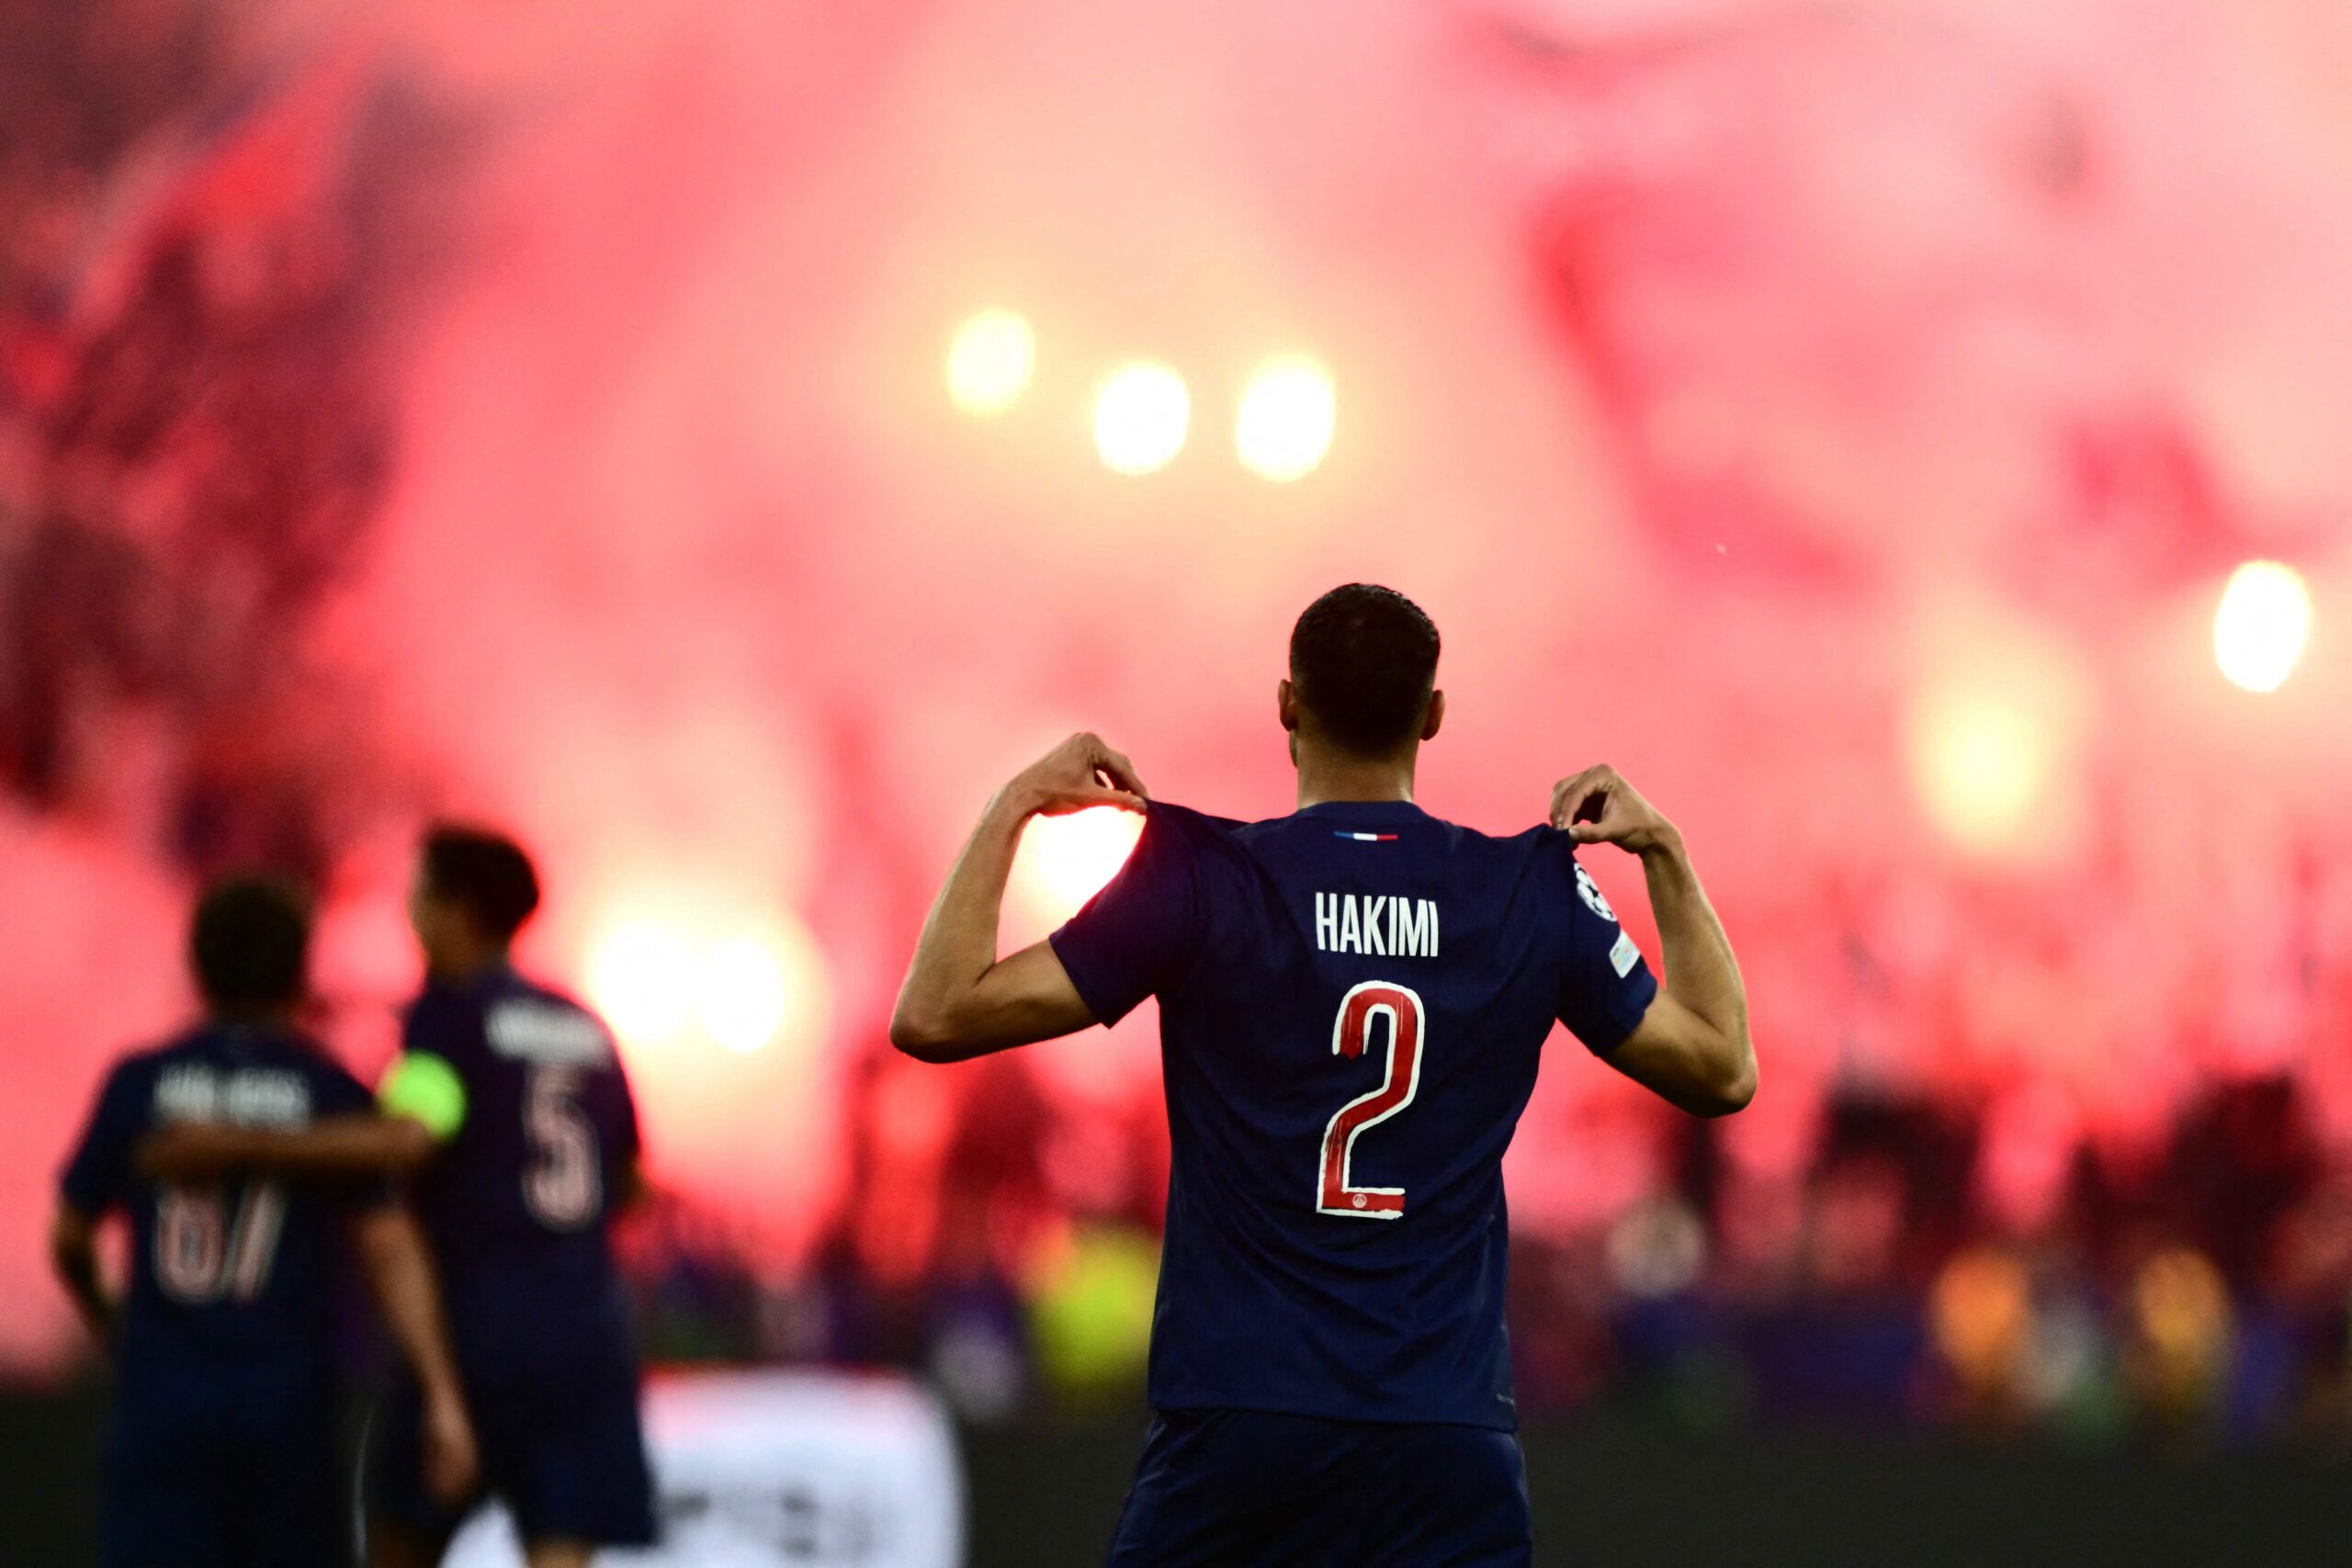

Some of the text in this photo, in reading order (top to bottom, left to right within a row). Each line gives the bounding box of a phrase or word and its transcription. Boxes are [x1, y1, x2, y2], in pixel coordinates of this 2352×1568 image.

[1315, 891, 1439, 957] HAKIMI
[522, 1060, 603, 1235] 5
[1316, 979, 1426, 1220] 2
